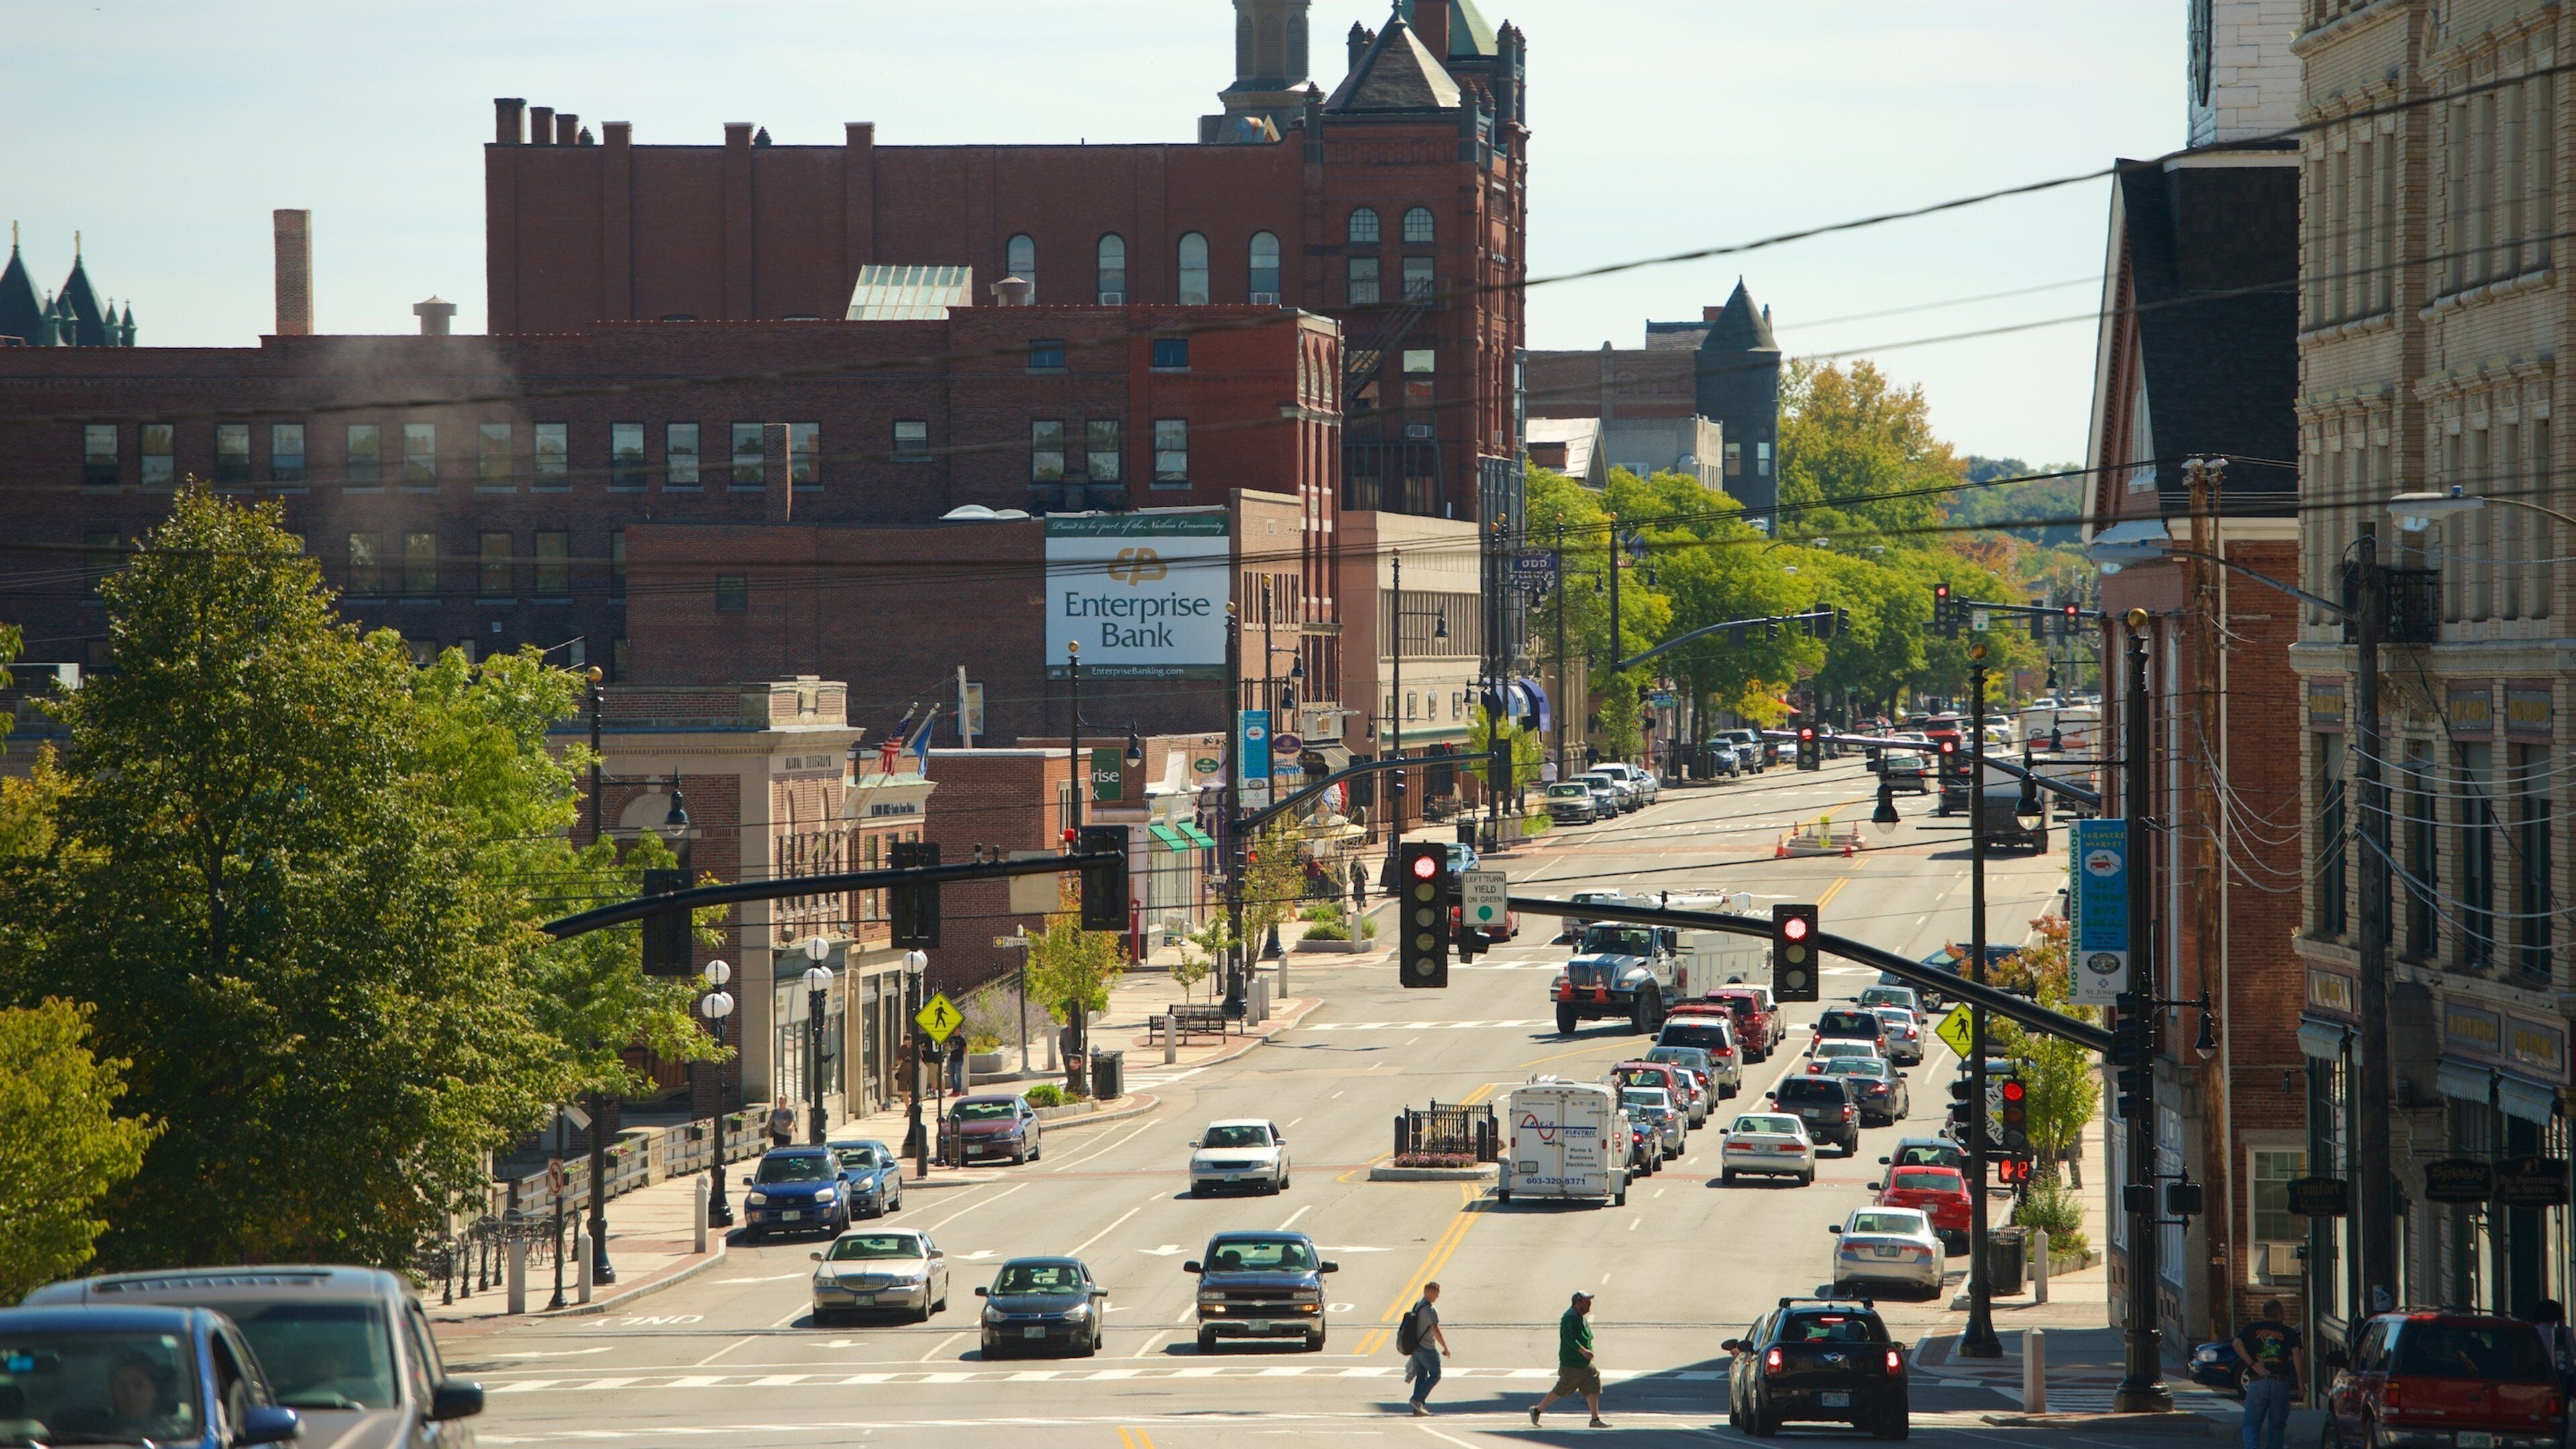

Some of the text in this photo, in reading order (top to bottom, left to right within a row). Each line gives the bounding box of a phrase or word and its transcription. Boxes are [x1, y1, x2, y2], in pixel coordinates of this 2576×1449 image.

[1051, 519, 1224, 535] Proud to be part of the Nashua Community
[1521, 559, 1547, 568] ODD
[1065, 591, 1211, 624] Enterprise
[1102, 622, 1175, 648] Bank
[1091, 667, 1185, 677] EnterpriseBanking.com
[1474, 885, 1496, 894] YIELD
[2070, 828, 2081, 997] downtownnashua.org
[2017, 1161, 2028, 1179] 12
[1526, 1177, 1587, 1185] 603-320-8371
